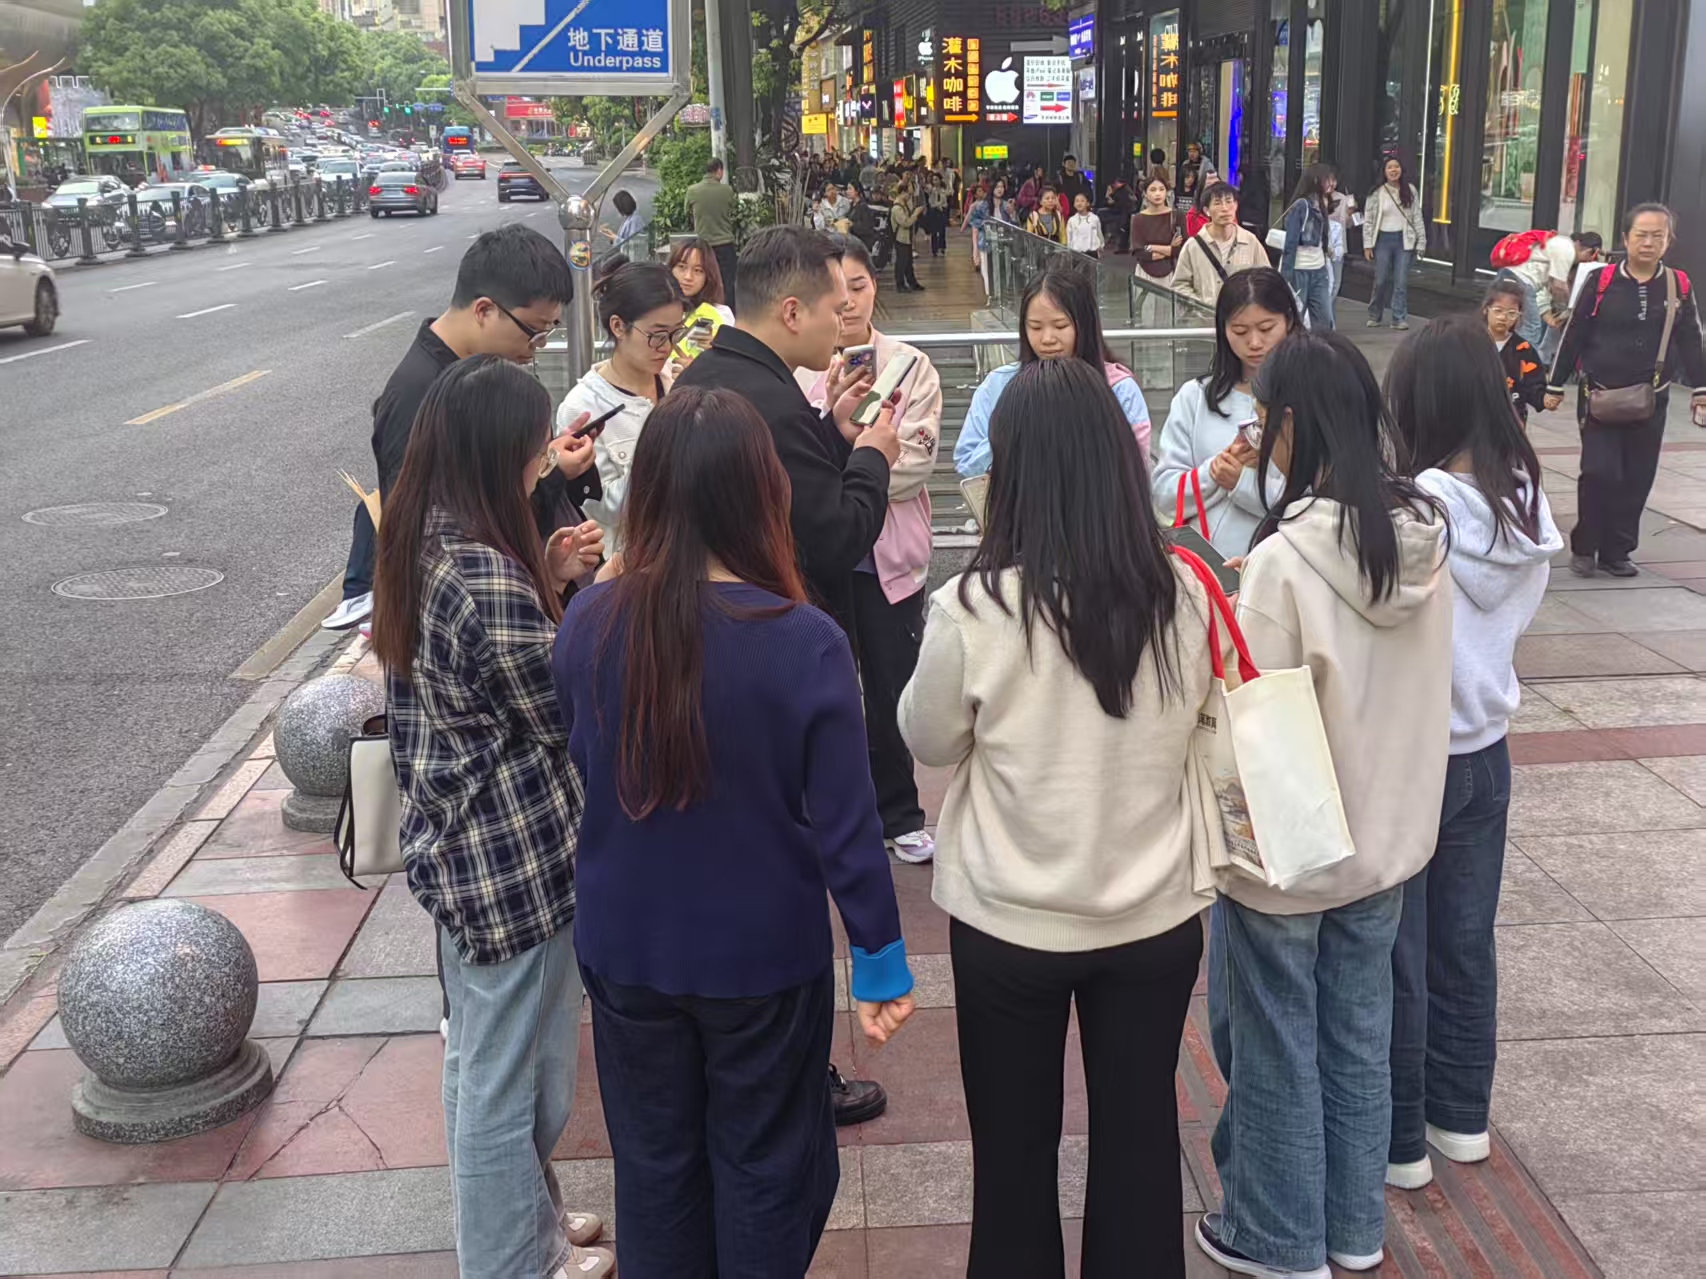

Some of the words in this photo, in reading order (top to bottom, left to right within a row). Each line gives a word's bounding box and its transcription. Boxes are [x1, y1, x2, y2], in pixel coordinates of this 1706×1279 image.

[568, 28, 664, 51] 地下通道
[569, 51, 662, 69] Underpass
[942, 37, 963, 112] 灌木咖啡
